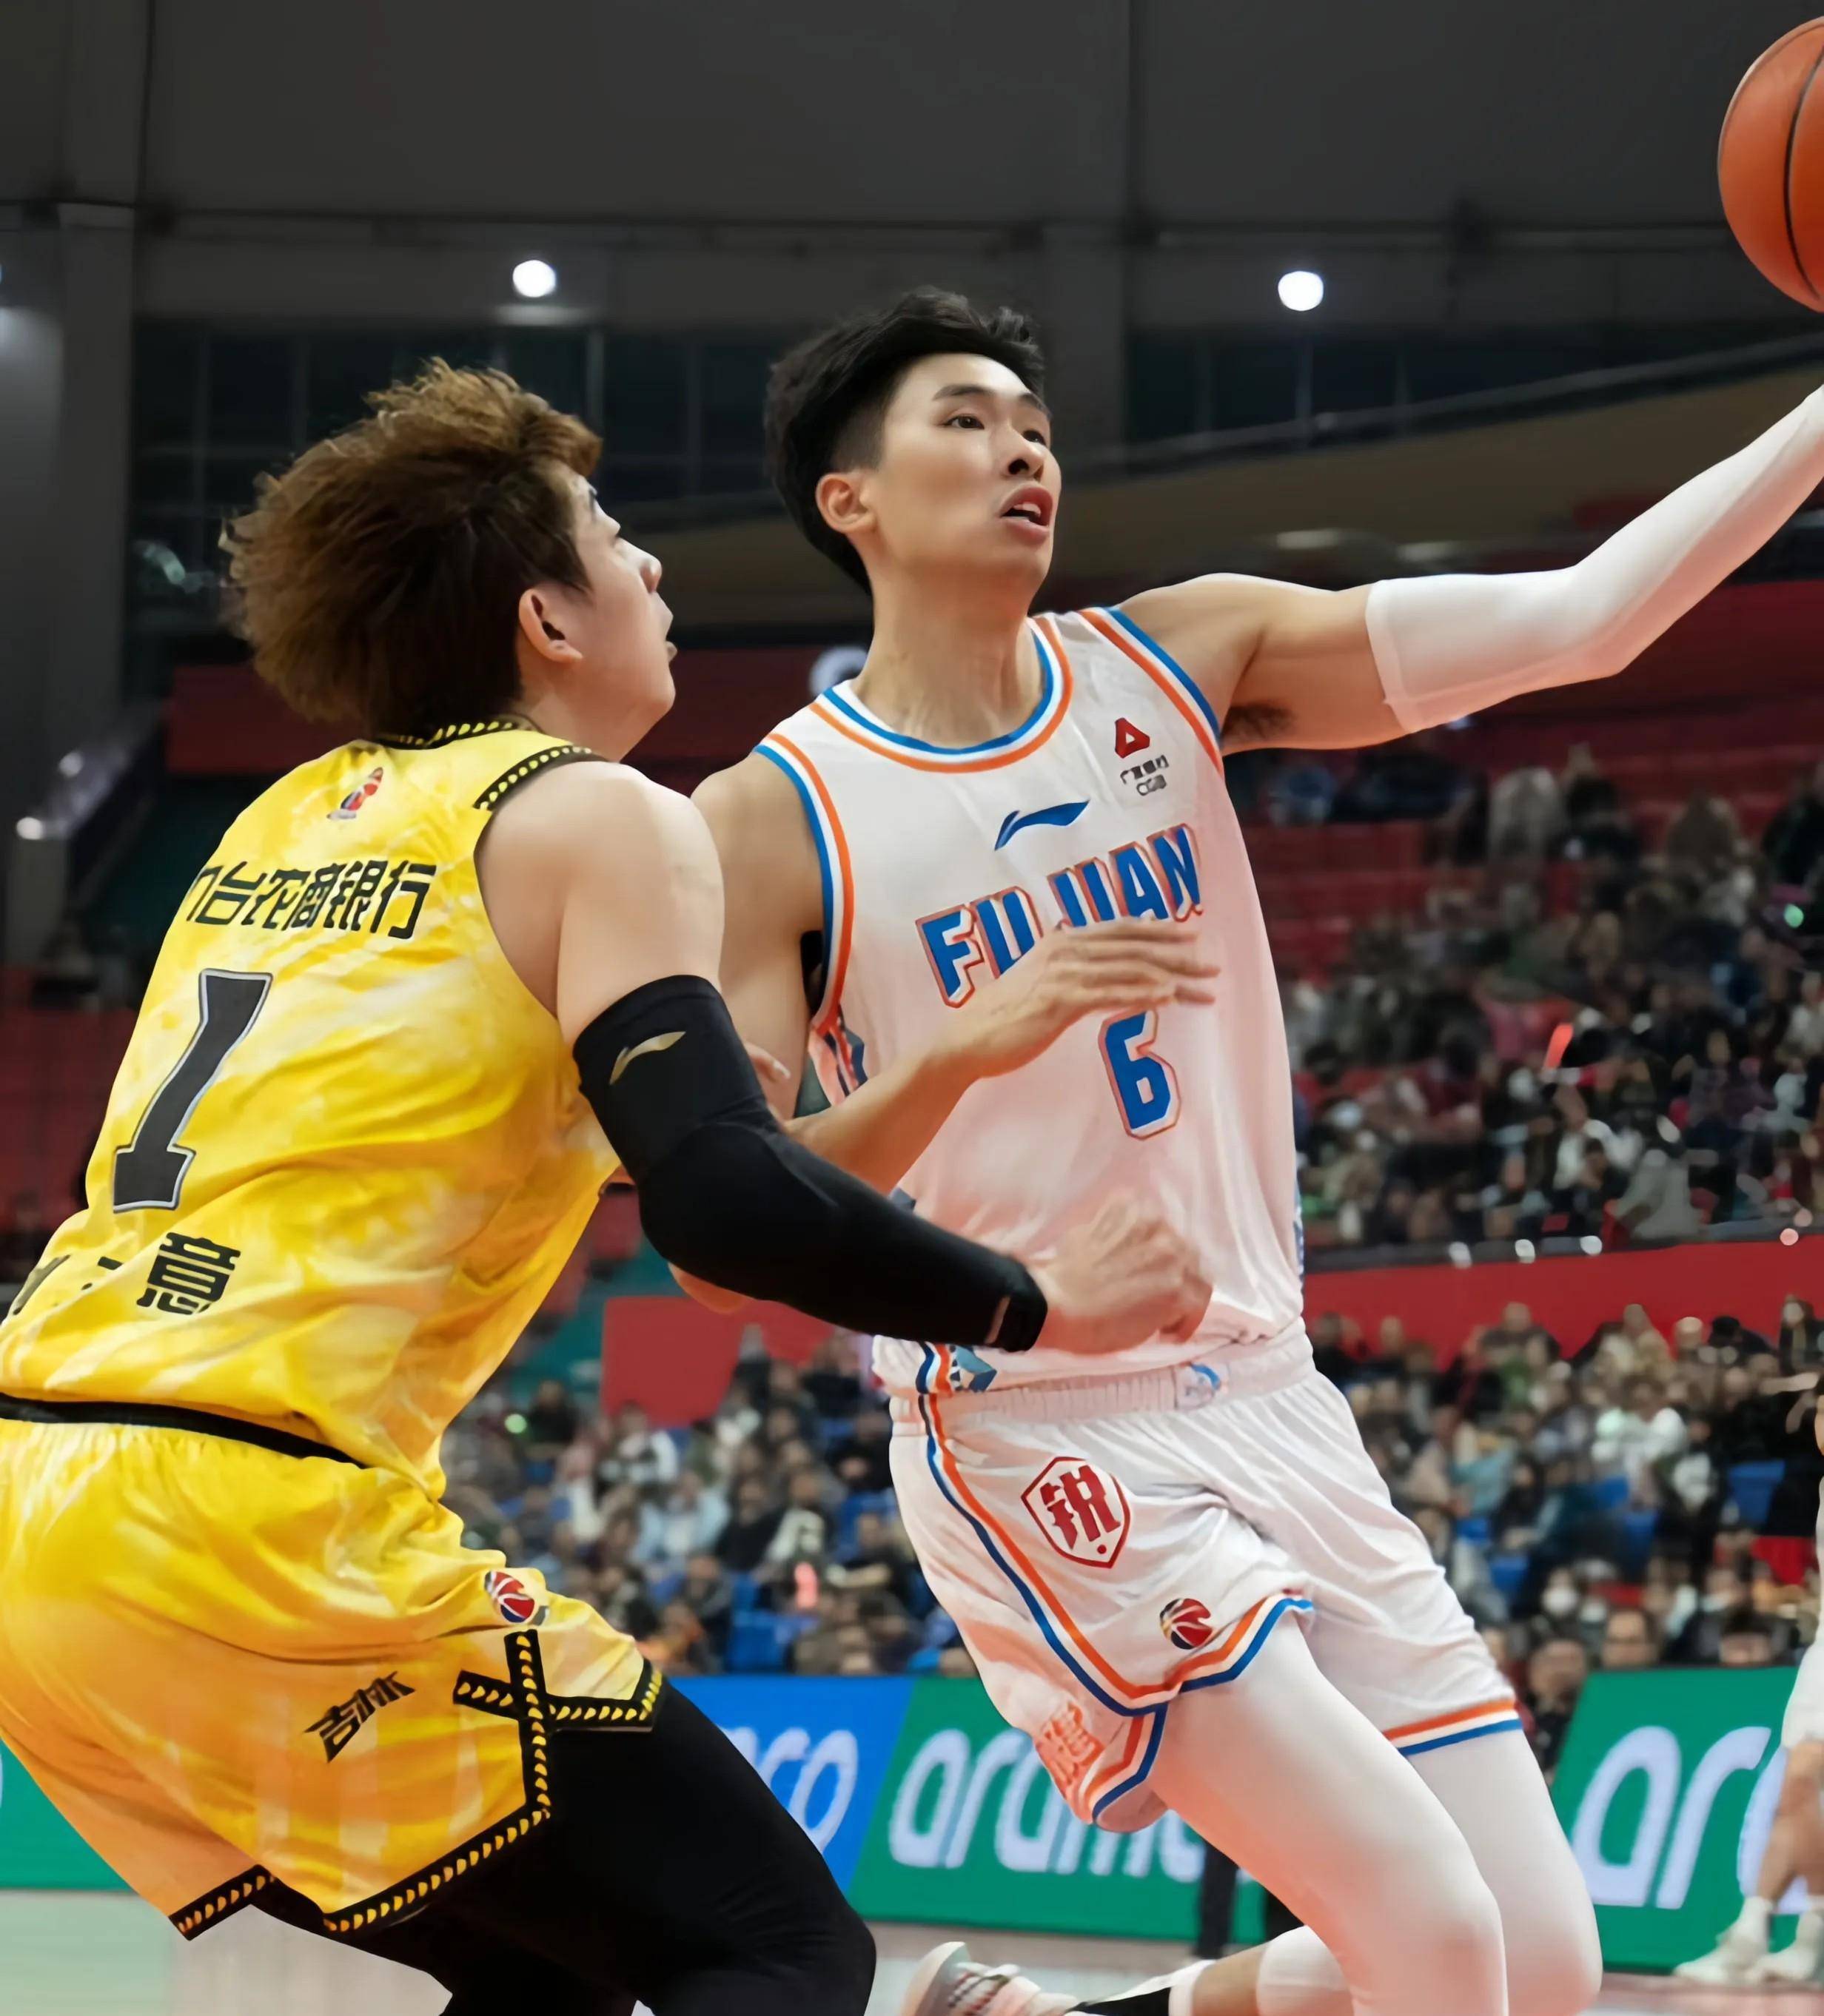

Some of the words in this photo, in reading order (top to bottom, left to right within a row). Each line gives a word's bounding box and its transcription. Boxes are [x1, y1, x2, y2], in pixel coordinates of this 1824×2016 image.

[113, 968, 273, 1214] 1
[1098, 1008, 1181, 1140] 6
[81, 1232, 241, 1315] 意
[303, 1670, 415, 1763] 吉林
[720, 1727, 859, 1855] co
[889, 1730, 1206, 1883] ara
